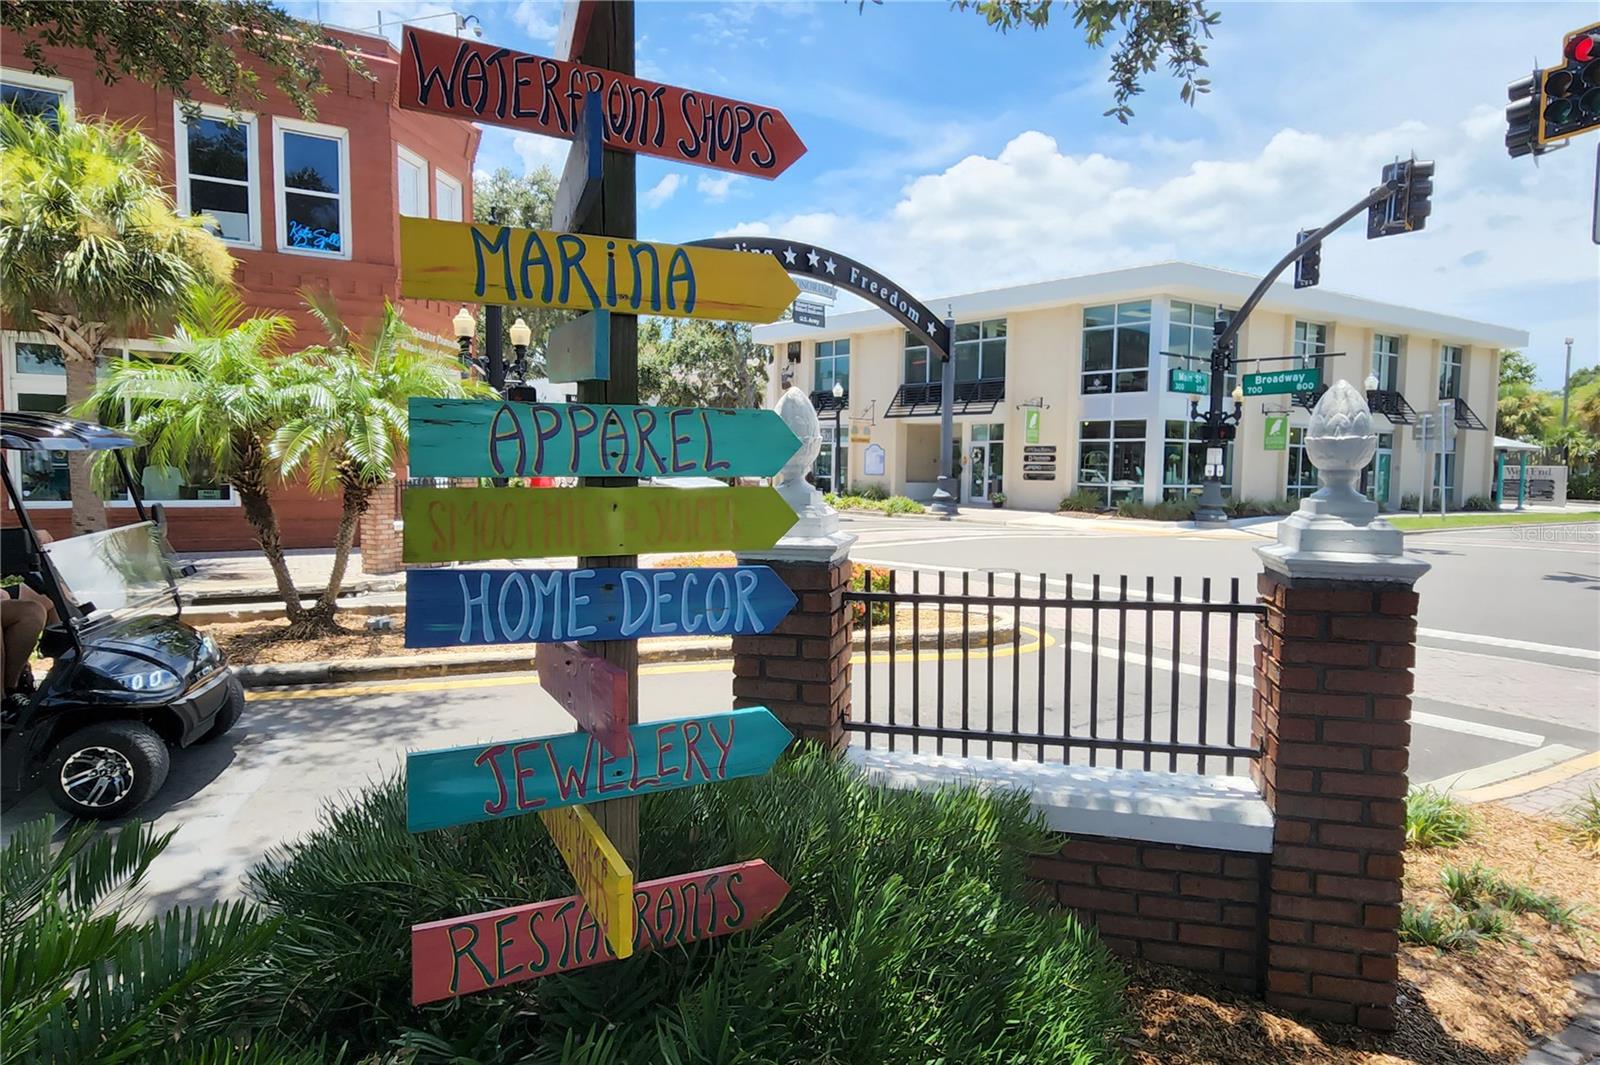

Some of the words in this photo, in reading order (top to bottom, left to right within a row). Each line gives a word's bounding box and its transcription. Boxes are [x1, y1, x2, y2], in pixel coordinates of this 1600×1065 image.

[678, 90, 776, 169] SHOPS
[849, 266, 920, 324] Freedom
[1178, 372, 1193, 382] Main
[1246, 386, 1263, 394] 700
[1255, 373, 1306, 385] Broadway
[488, 404, 731, 476] APPAREL
[458, 569, 597, 644] HOME
[620, 569, 765, 637] DECOR
[446, 872, 744, 995] RESTARANTS
